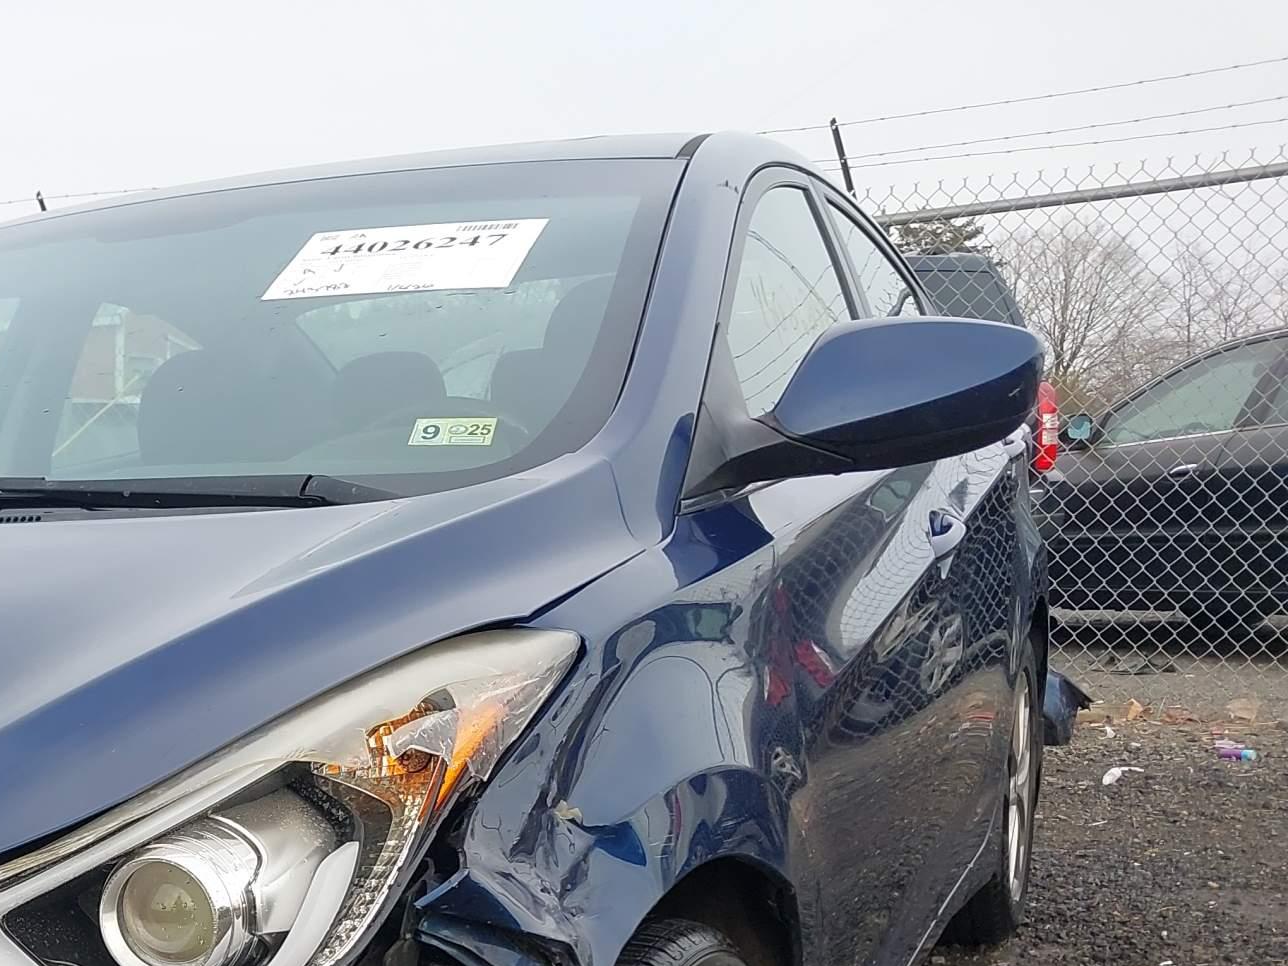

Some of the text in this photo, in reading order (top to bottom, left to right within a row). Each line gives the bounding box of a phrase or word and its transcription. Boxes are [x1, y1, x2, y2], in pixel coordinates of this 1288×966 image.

[320, 233, 510, 256] 44026247
[421, 424, 441, 440] 9
[467, 423, 493, 436] 25
